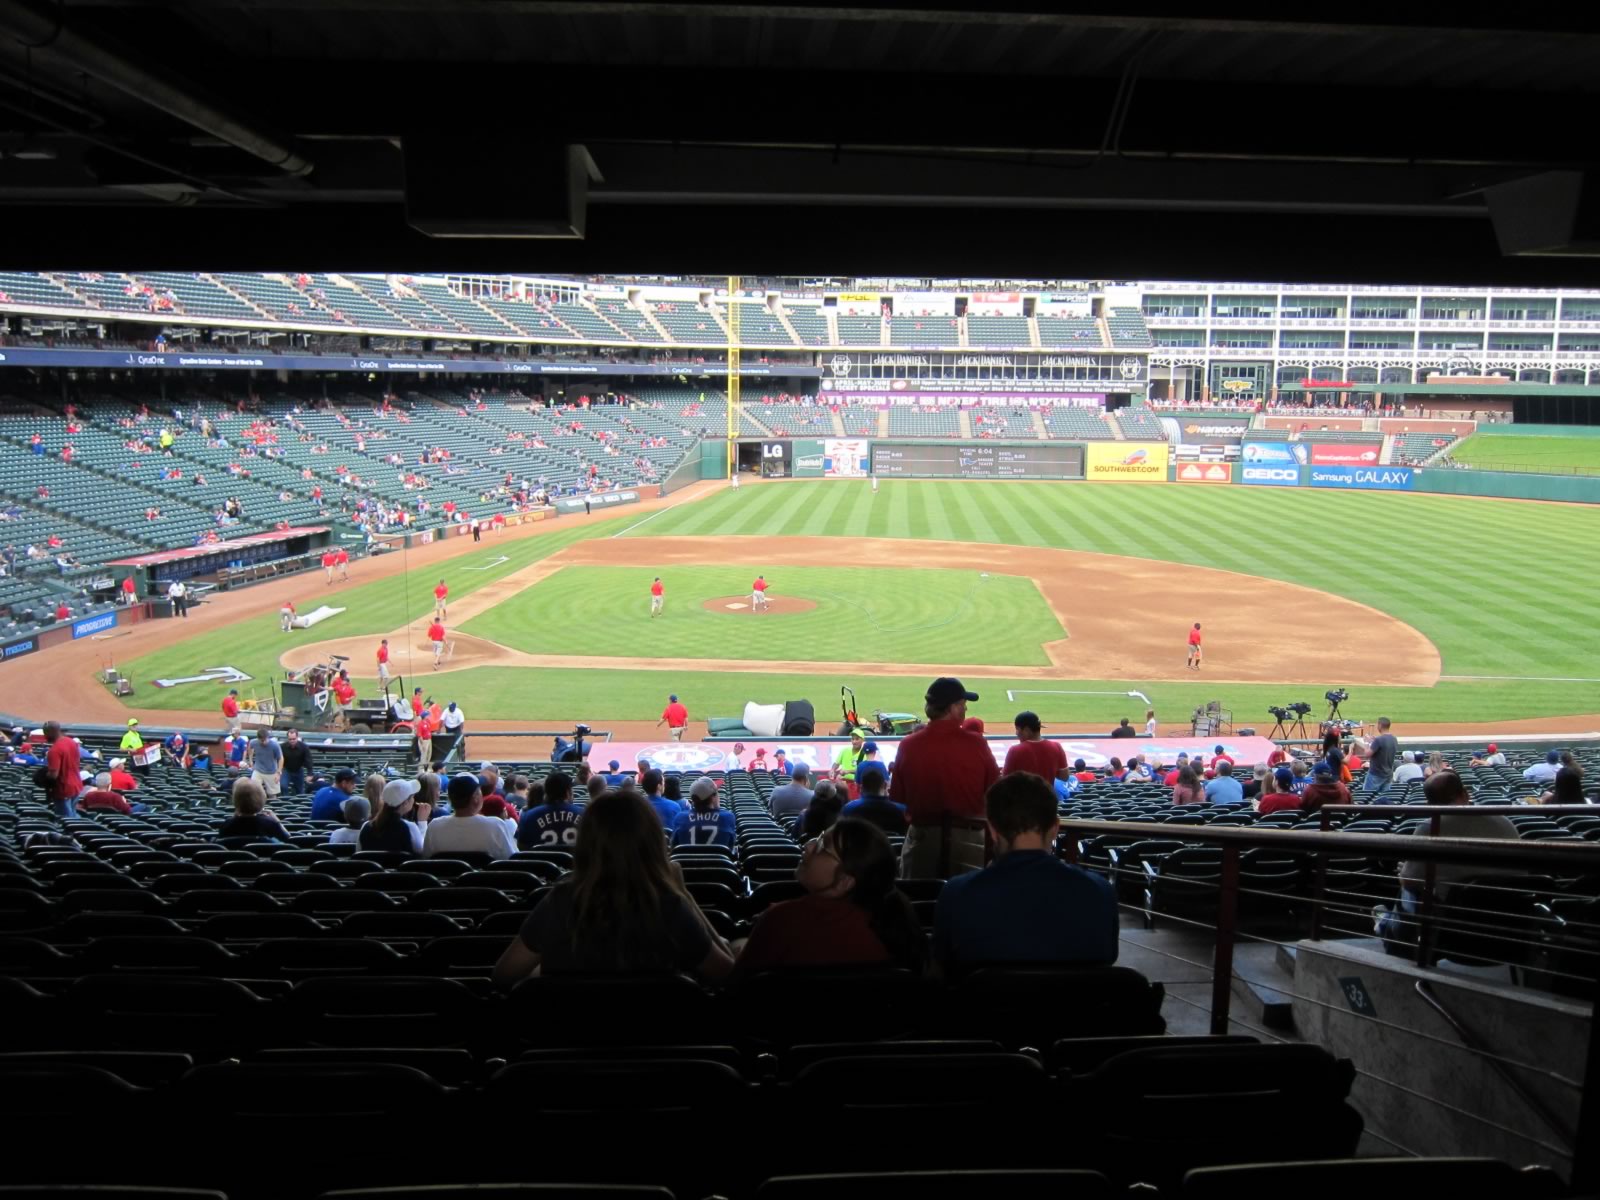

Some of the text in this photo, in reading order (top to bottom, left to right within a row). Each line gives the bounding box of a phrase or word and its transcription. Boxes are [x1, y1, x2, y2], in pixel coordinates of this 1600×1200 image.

[138, 355, 165, 366] CyrusOne
[874, 354, 895, 365] JACK
[958, 355, 979, 366] JACK
[1042, 355, 1063, 366] JACK
[764, 445, 783, 458] LG
[1094, 465, 1159, 473] SOUTHWEST.COM
[1244, 468, 1297, 480] GEICO
[1313, 470, 1408, 484] Samsung GALAXY
[76, 615, 114, 635] PROGRESSIVE
[537, 811, 582, 828] BELTRE
[689, 812, 720, 823] CHOO
[688, 825, 718, 845] 17
